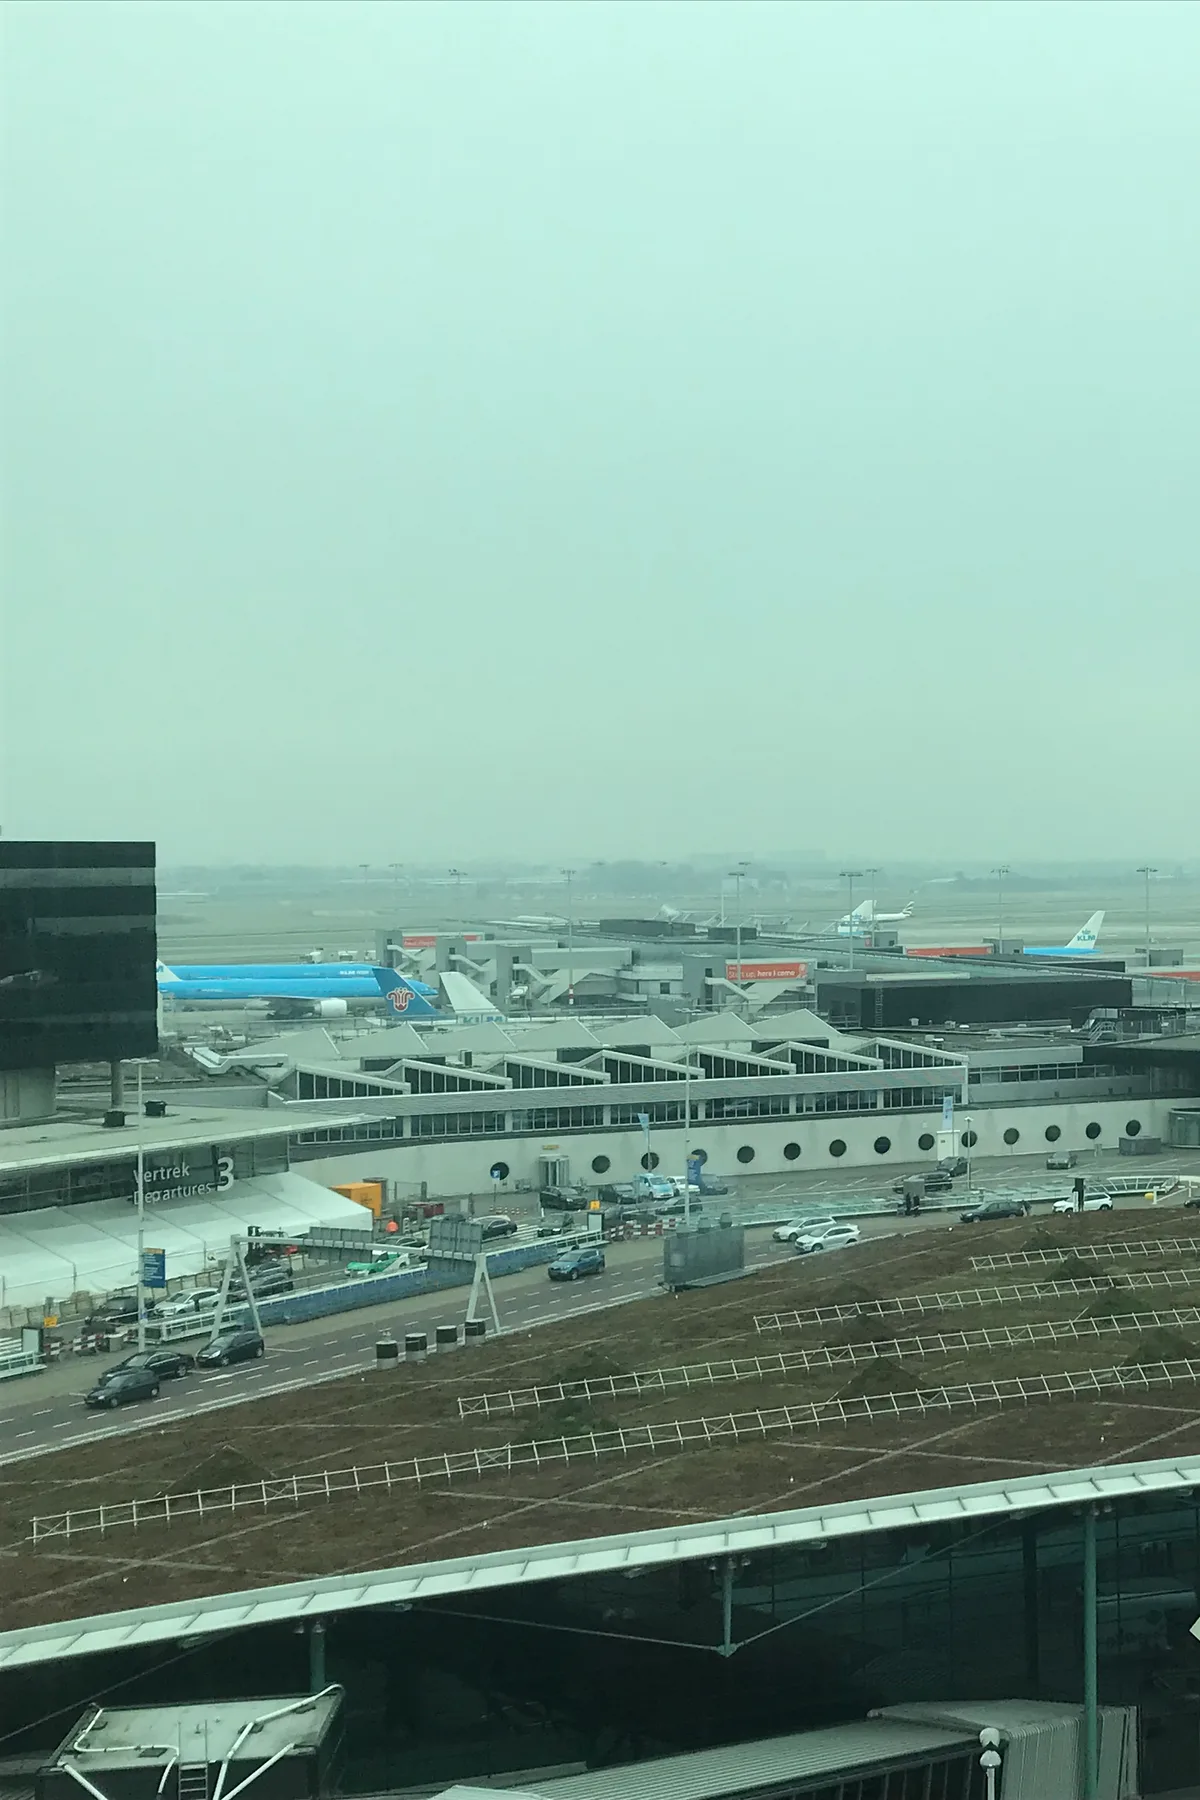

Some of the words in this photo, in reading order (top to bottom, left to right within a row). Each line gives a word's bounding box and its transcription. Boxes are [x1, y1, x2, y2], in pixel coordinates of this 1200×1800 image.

[133, 1162, 190, 1184] Vertrek
[133, 1182, 212, 1205] Departures
[217, 1156, 234, 1191] 3
